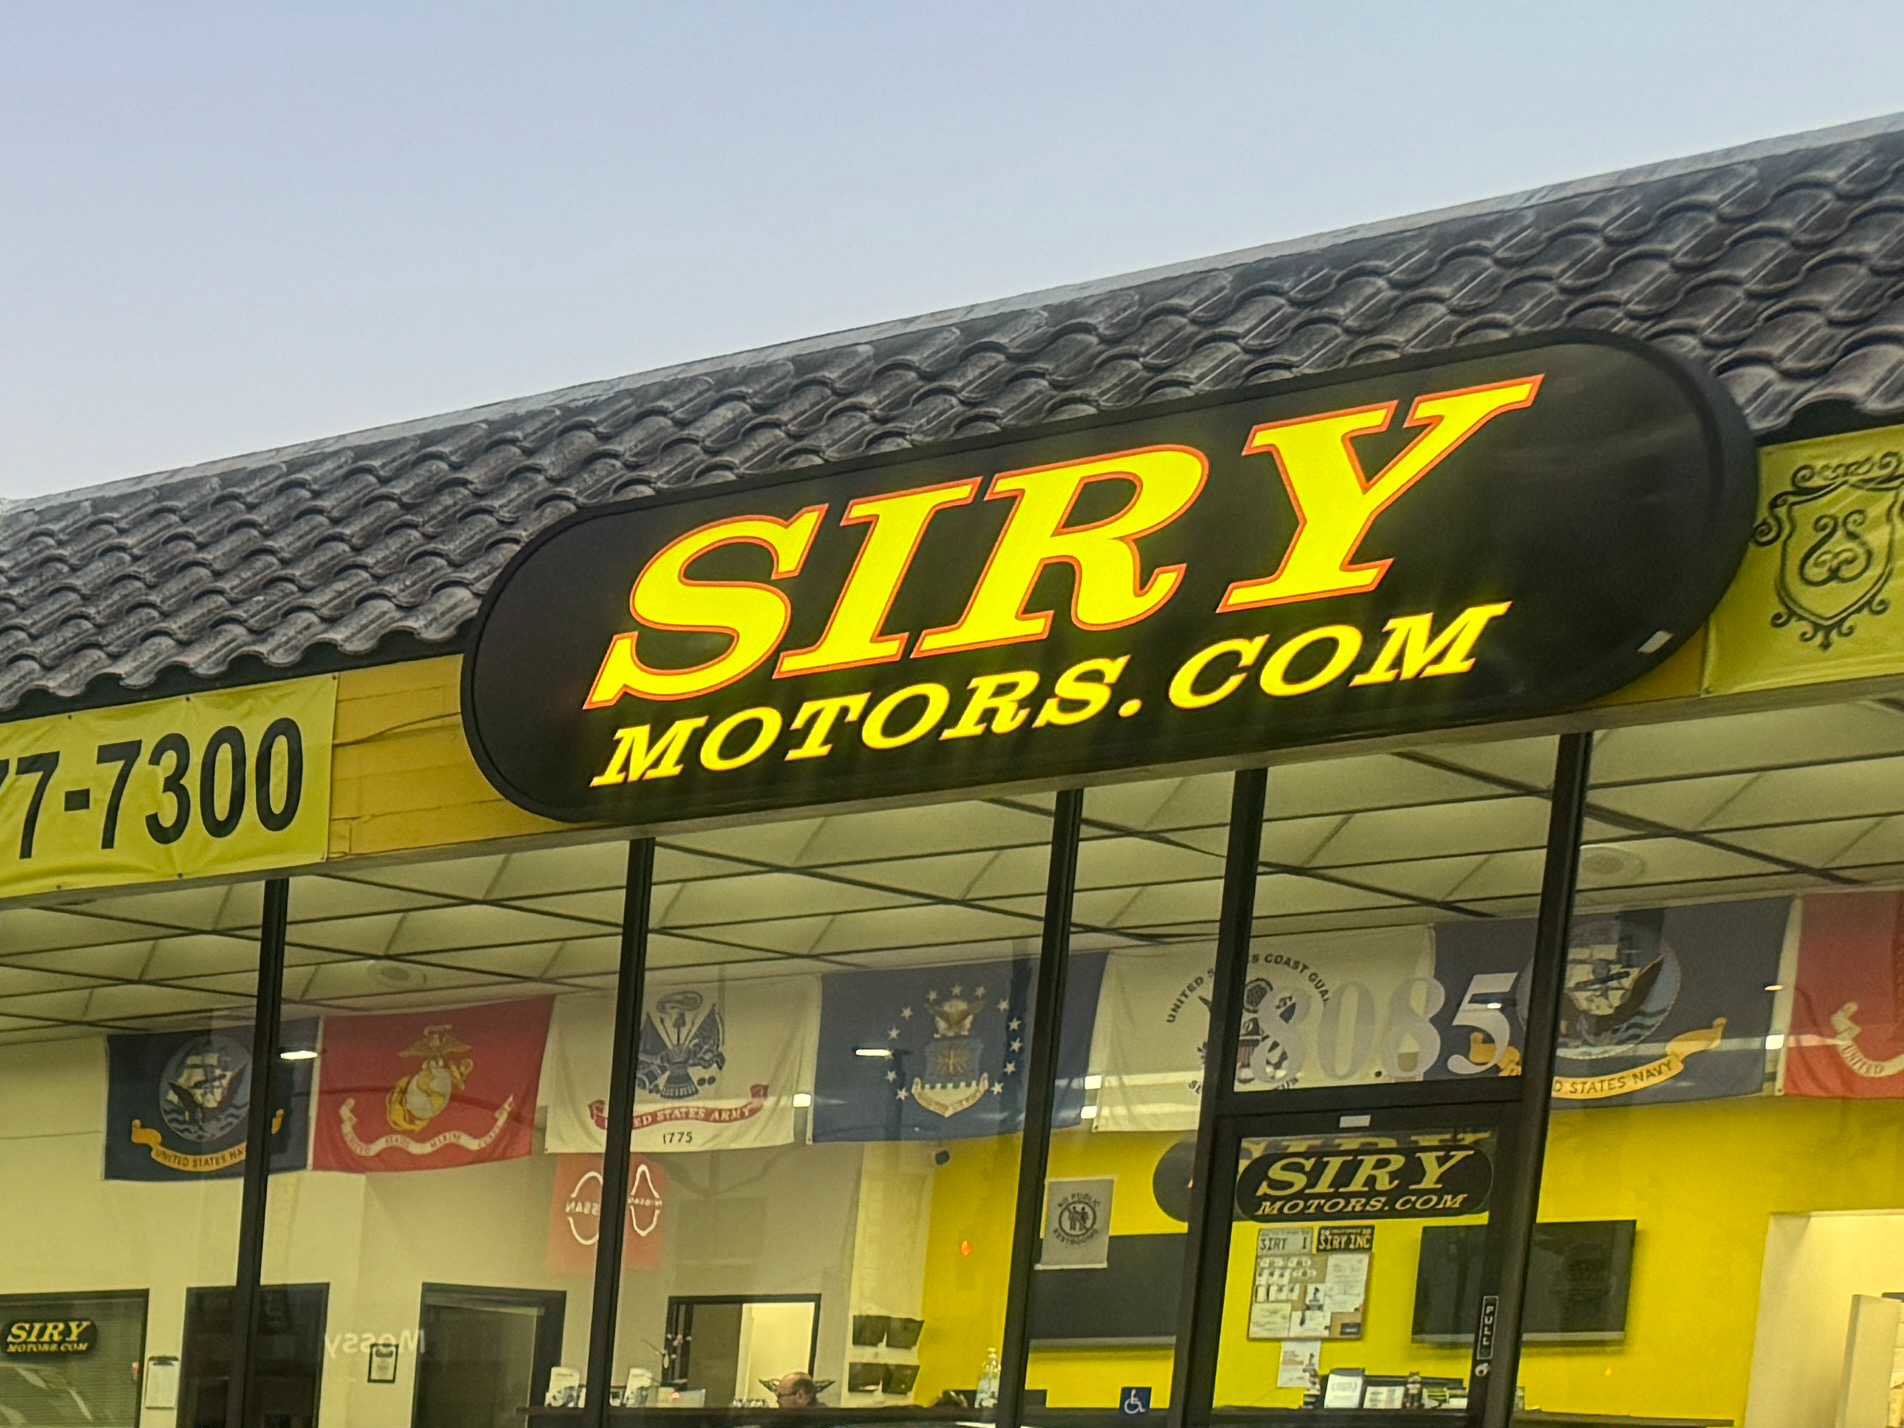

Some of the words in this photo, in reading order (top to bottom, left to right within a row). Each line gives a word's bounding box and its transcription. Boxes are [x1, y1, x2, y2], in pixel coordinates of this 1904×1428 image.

[584, 373, 1545, 710] SIRY
[591, 601, 1511, 787] MOTORS.COM
[1263, 953, 1309, 975] COAST
[1166, 975, 1204, 1024] UNITED
[1250, 971, 1518, 1084] 8085
[1569, 1076, 1626, 1095] STATES
[1631, 1060, 1673, 1084] NAVY
[656, 1108, 706, 1123] STATES
[709, 1104, 754, 1122] ARMY
[662, 1130, 693, 1145] 1775
[1256, 1150, 1474, 1197] SIRY
[1255, 1194, 1468, 1216] MOTORS.COM
[6, 1320, 91, 1342] SIRY
[1482, 1305, 1494, 1346] PULL
